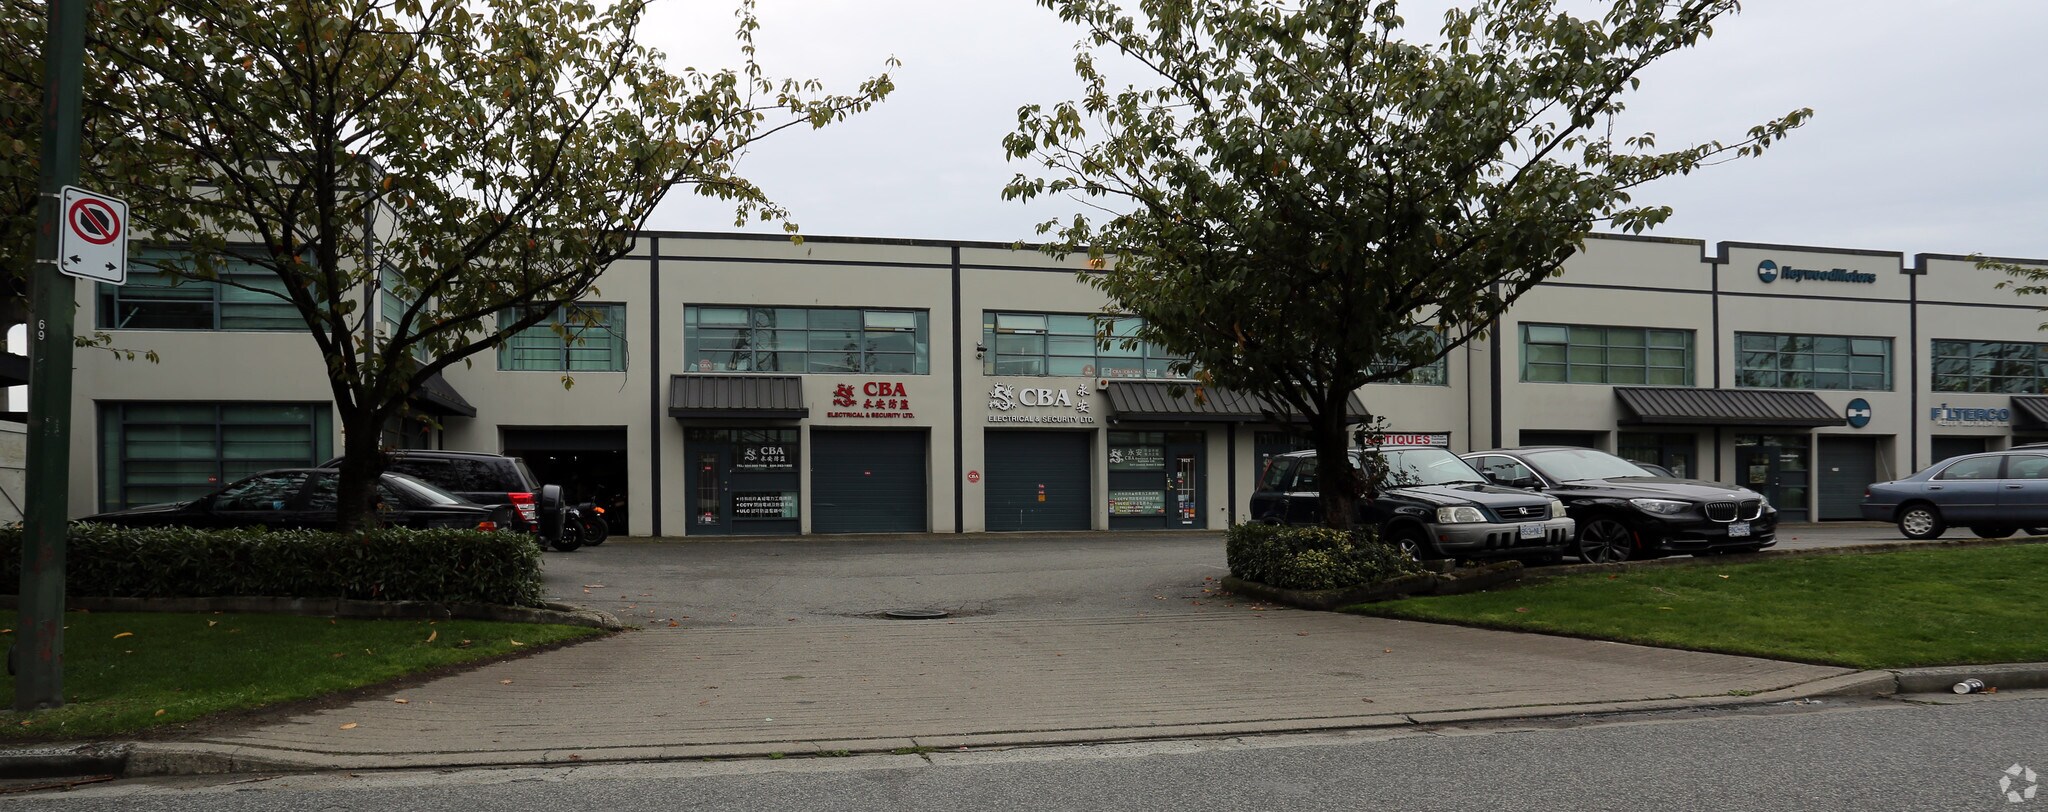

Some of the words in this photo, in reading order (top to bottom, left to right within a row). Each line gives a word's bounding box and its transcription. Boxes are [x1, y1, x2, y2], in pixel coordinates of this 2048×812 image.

[863, 381, 907, 397] CBA
[1018, 388, 1072, 407] CBA
[988, 415, 1034, 423] ELECTRICAL
[1042, 415, 1078, 423] SECURITY
[1080, 416, 1095, 424] LTD.
[760, 446, 784, 455] CBA
